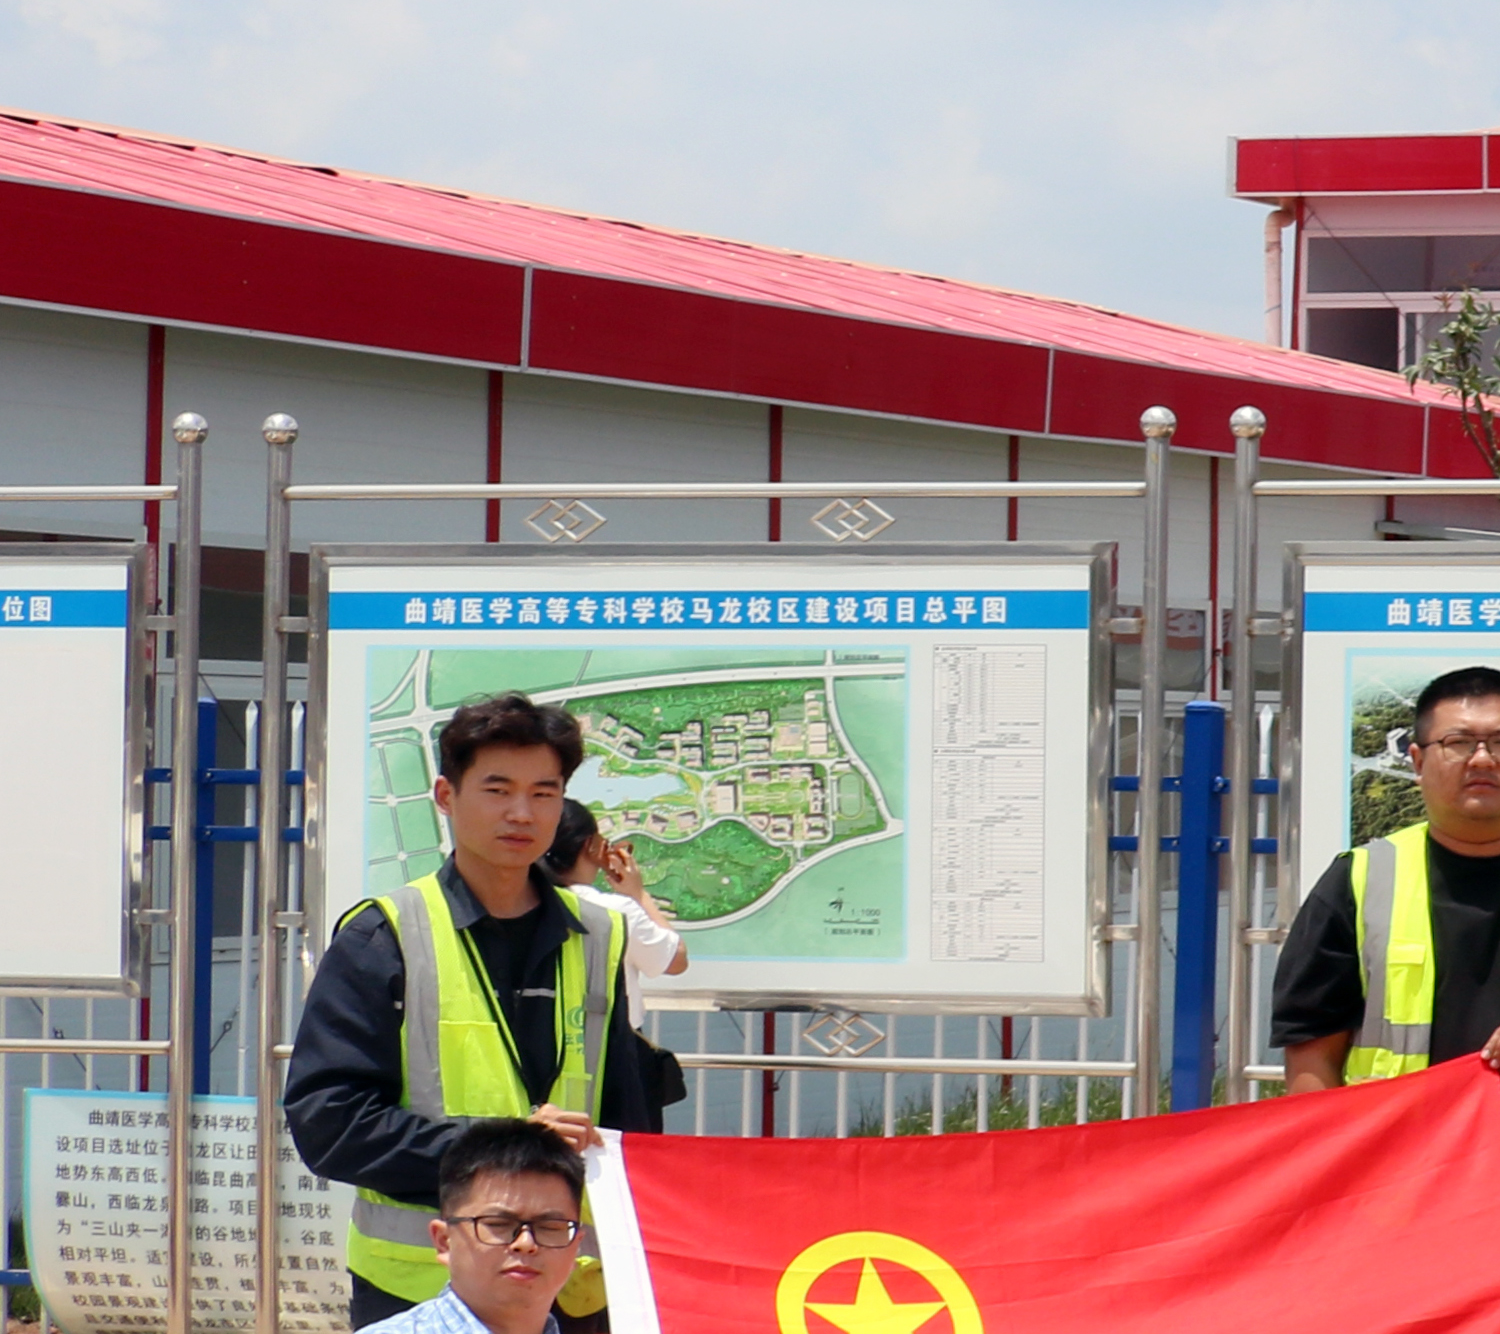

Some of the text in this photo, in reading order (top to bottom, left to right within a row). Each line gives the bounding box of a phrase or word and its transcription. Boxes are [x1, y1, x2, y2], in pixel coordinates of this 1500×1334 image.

[2, 596, 52, 622] 位图
[404, 596, 1008, 624] 曲靖医学高等专科学校马龙校区建设项目总平图
